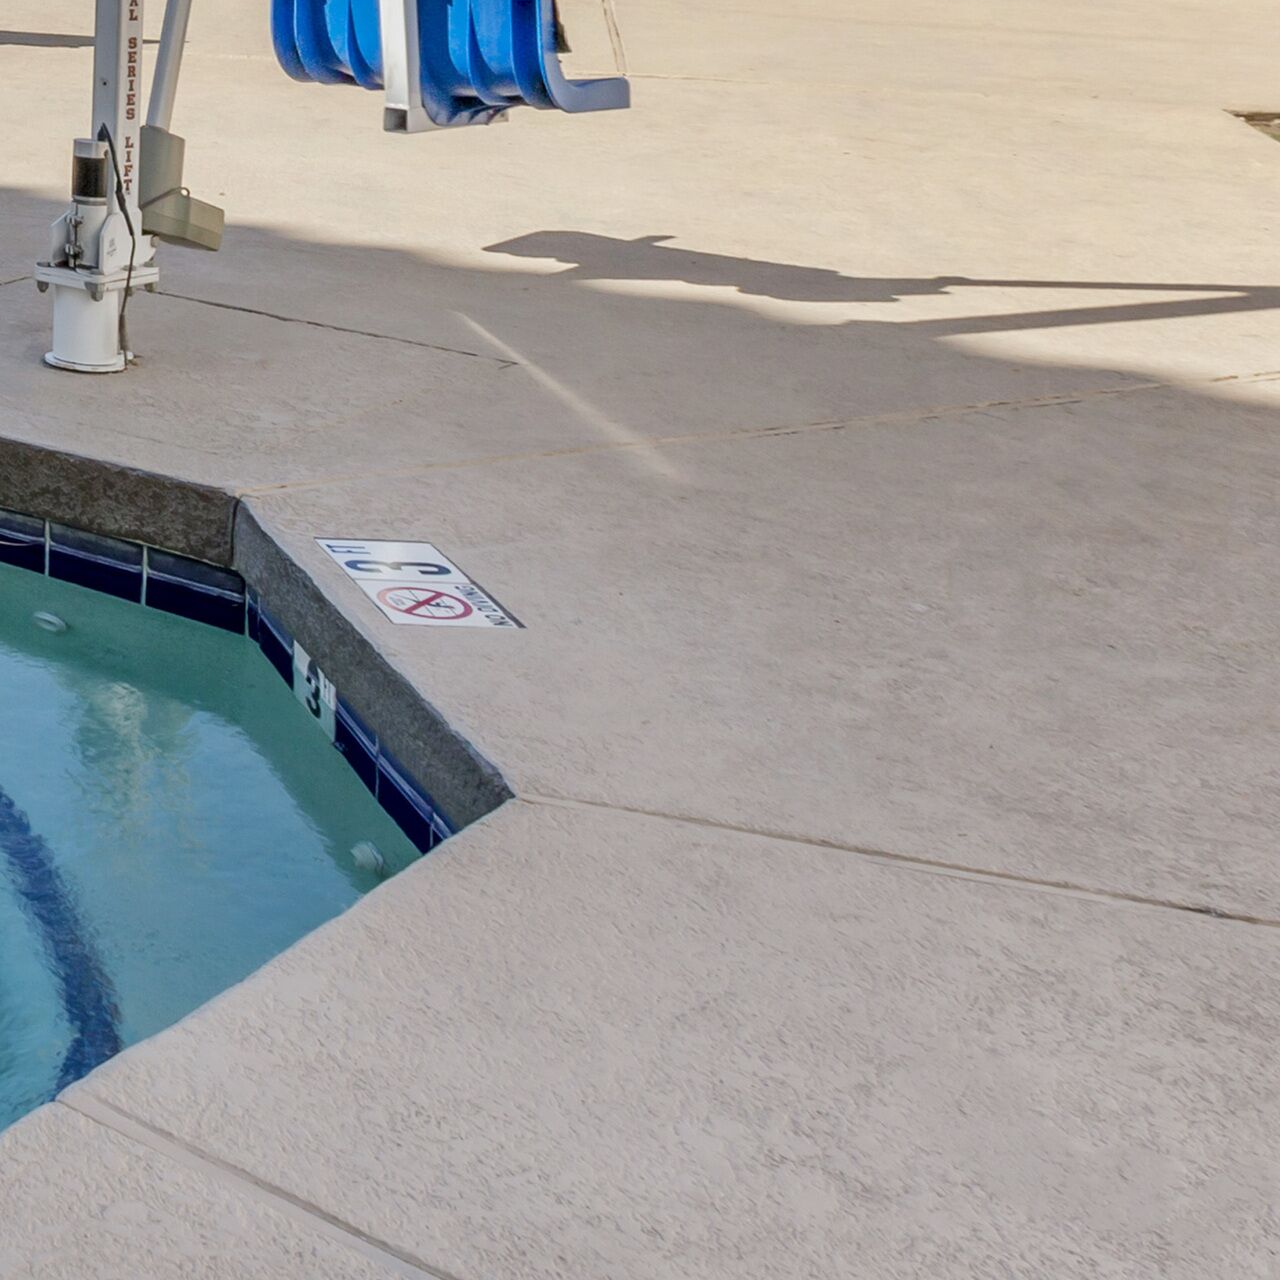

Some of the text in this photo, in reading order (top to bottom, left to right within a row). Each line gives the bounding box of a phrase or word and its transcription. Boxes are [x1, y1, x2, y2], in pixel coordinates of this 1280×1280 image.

[126, 36, 138, 120] SERIES
[123, 136, 134, 191] LIFT
[325, 543, 451, 576] 3 FT
[484, 613, 513, 627] NO
[305, 659, 322, 719] 3
